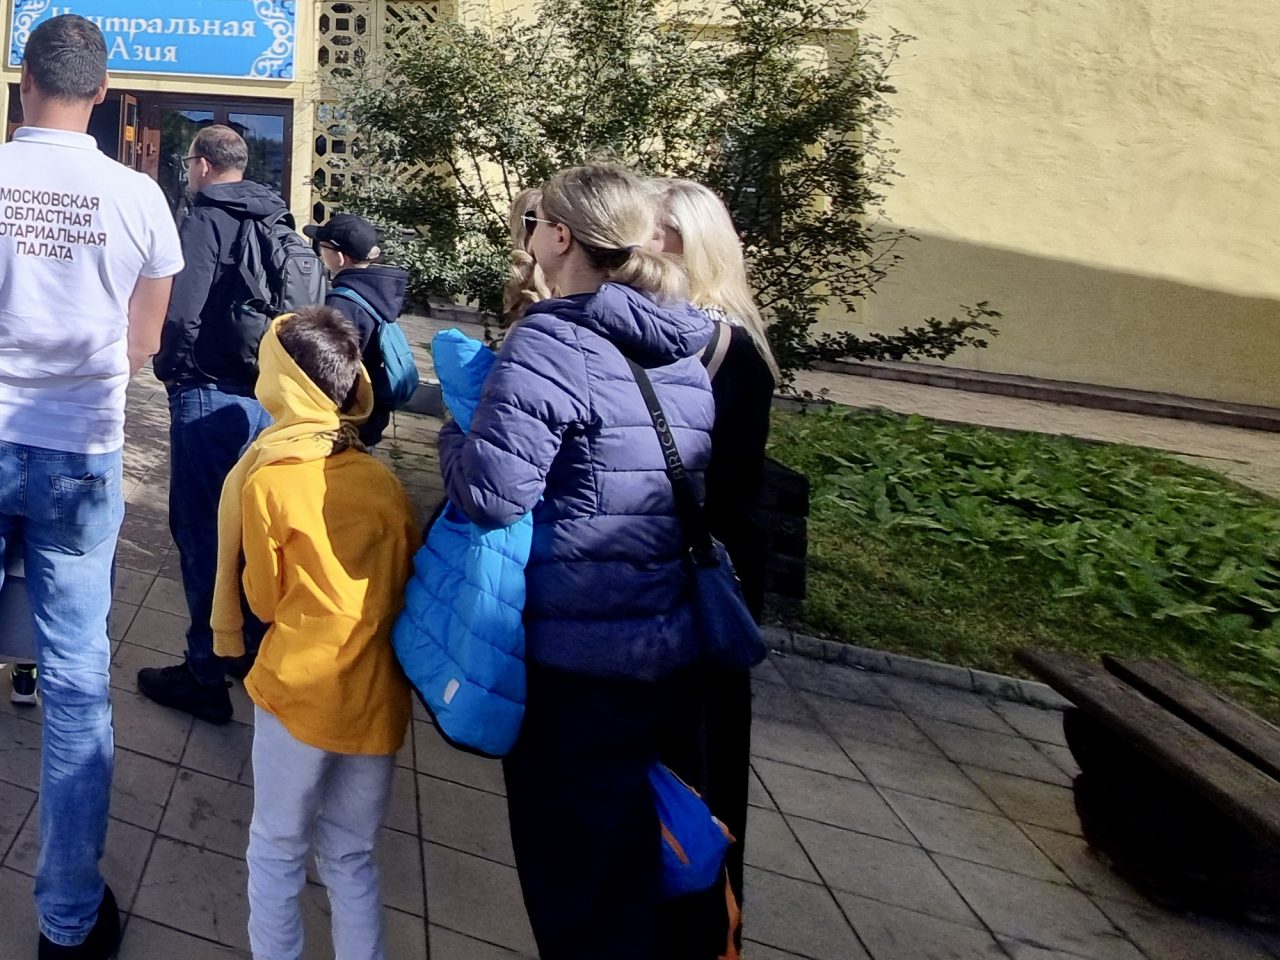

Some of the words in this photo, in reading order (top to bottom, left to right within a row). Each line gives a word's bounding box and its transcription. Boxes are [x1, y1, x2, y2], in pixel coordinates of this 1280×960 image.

[51, 6, 256, 41] тральная
[108, 36, 178, 62] Азия
[0, 187, 100, 211] МОСКОВСКАЯ
[4, 205, 92, 227] ОБЛАСТНАЯ
[16, 241, 73, 260] ПАЛАТА
